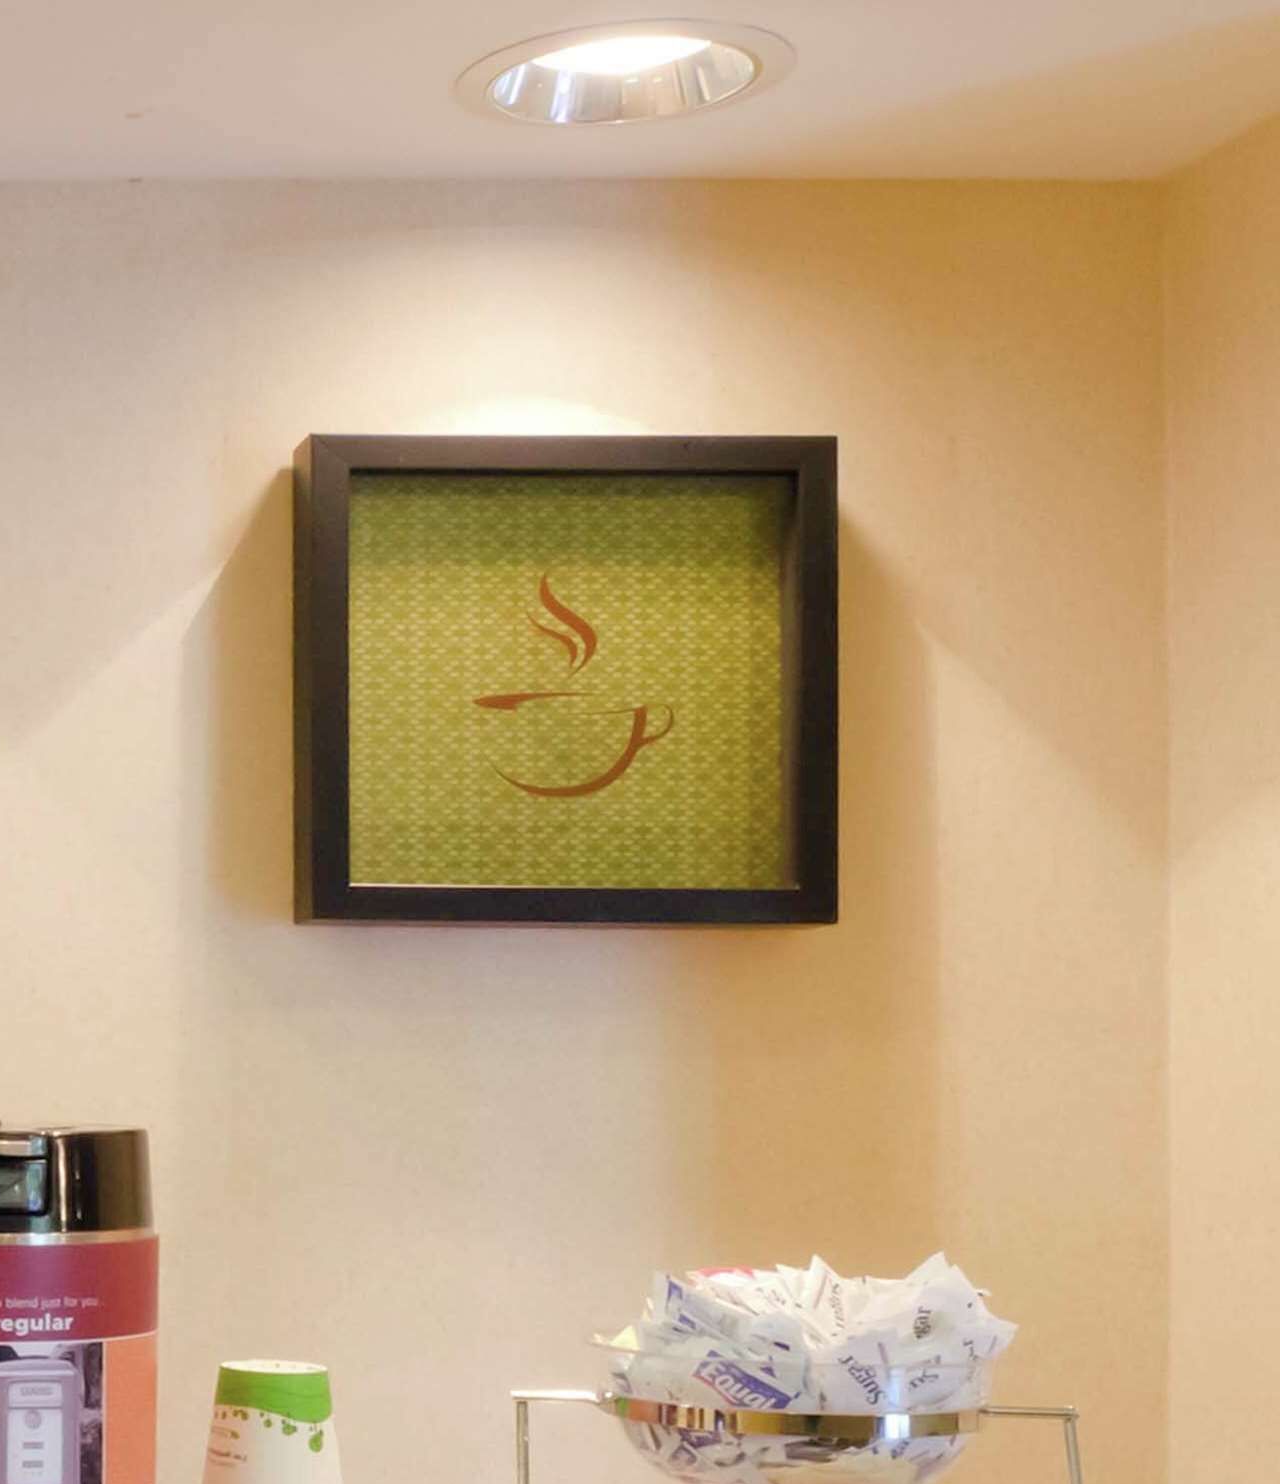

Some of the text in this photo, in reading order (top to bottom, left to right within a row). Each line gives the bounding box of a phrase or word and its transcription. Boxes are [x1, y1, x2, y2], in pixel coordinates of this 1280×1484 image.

[5, 1297, 38, 1308] blend
[41, 1297, 61, 1310] just
[63, 1296, 78, 1307] for
[838, 1355, 886, 1405] Sugar
